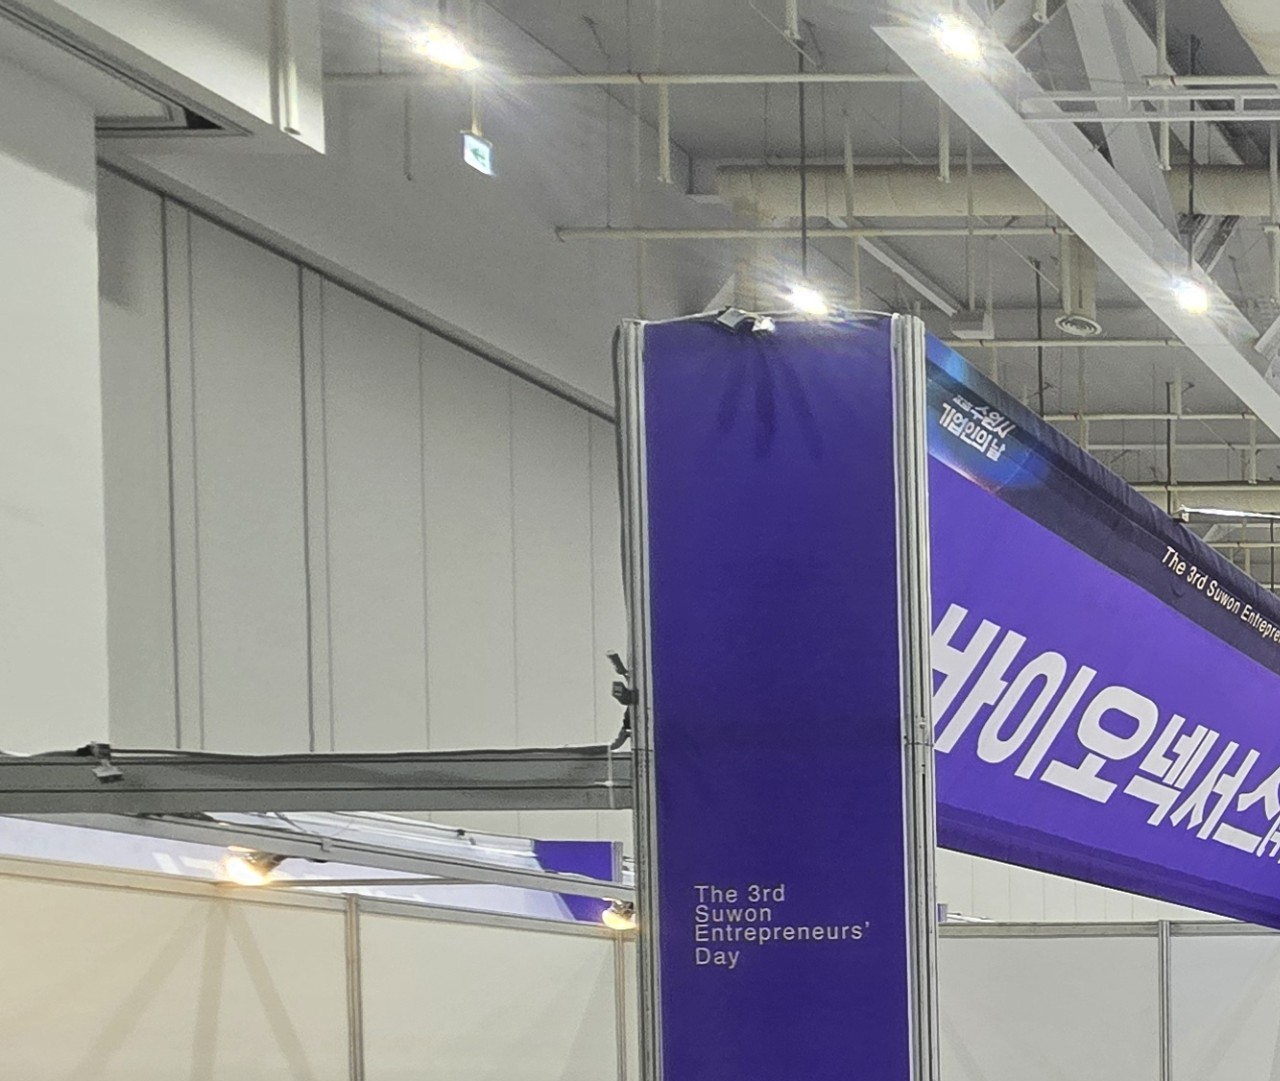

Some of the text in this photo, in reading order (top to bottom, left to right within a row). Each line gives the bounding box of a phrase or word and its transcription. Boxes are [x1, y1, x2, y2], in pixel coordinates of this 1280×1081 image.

[940, 402, 1006, 461] 기업인의 날
[1161, 545, 1185, 576] The
[1187, 566, 1206, 590] 3rd
[1207, 580, 1241, 615] Suwon
[695, 883, 785, 903] The 3rd
[695, 905, 772, 923] Suwon
[695, 947, 740, 970] Day
